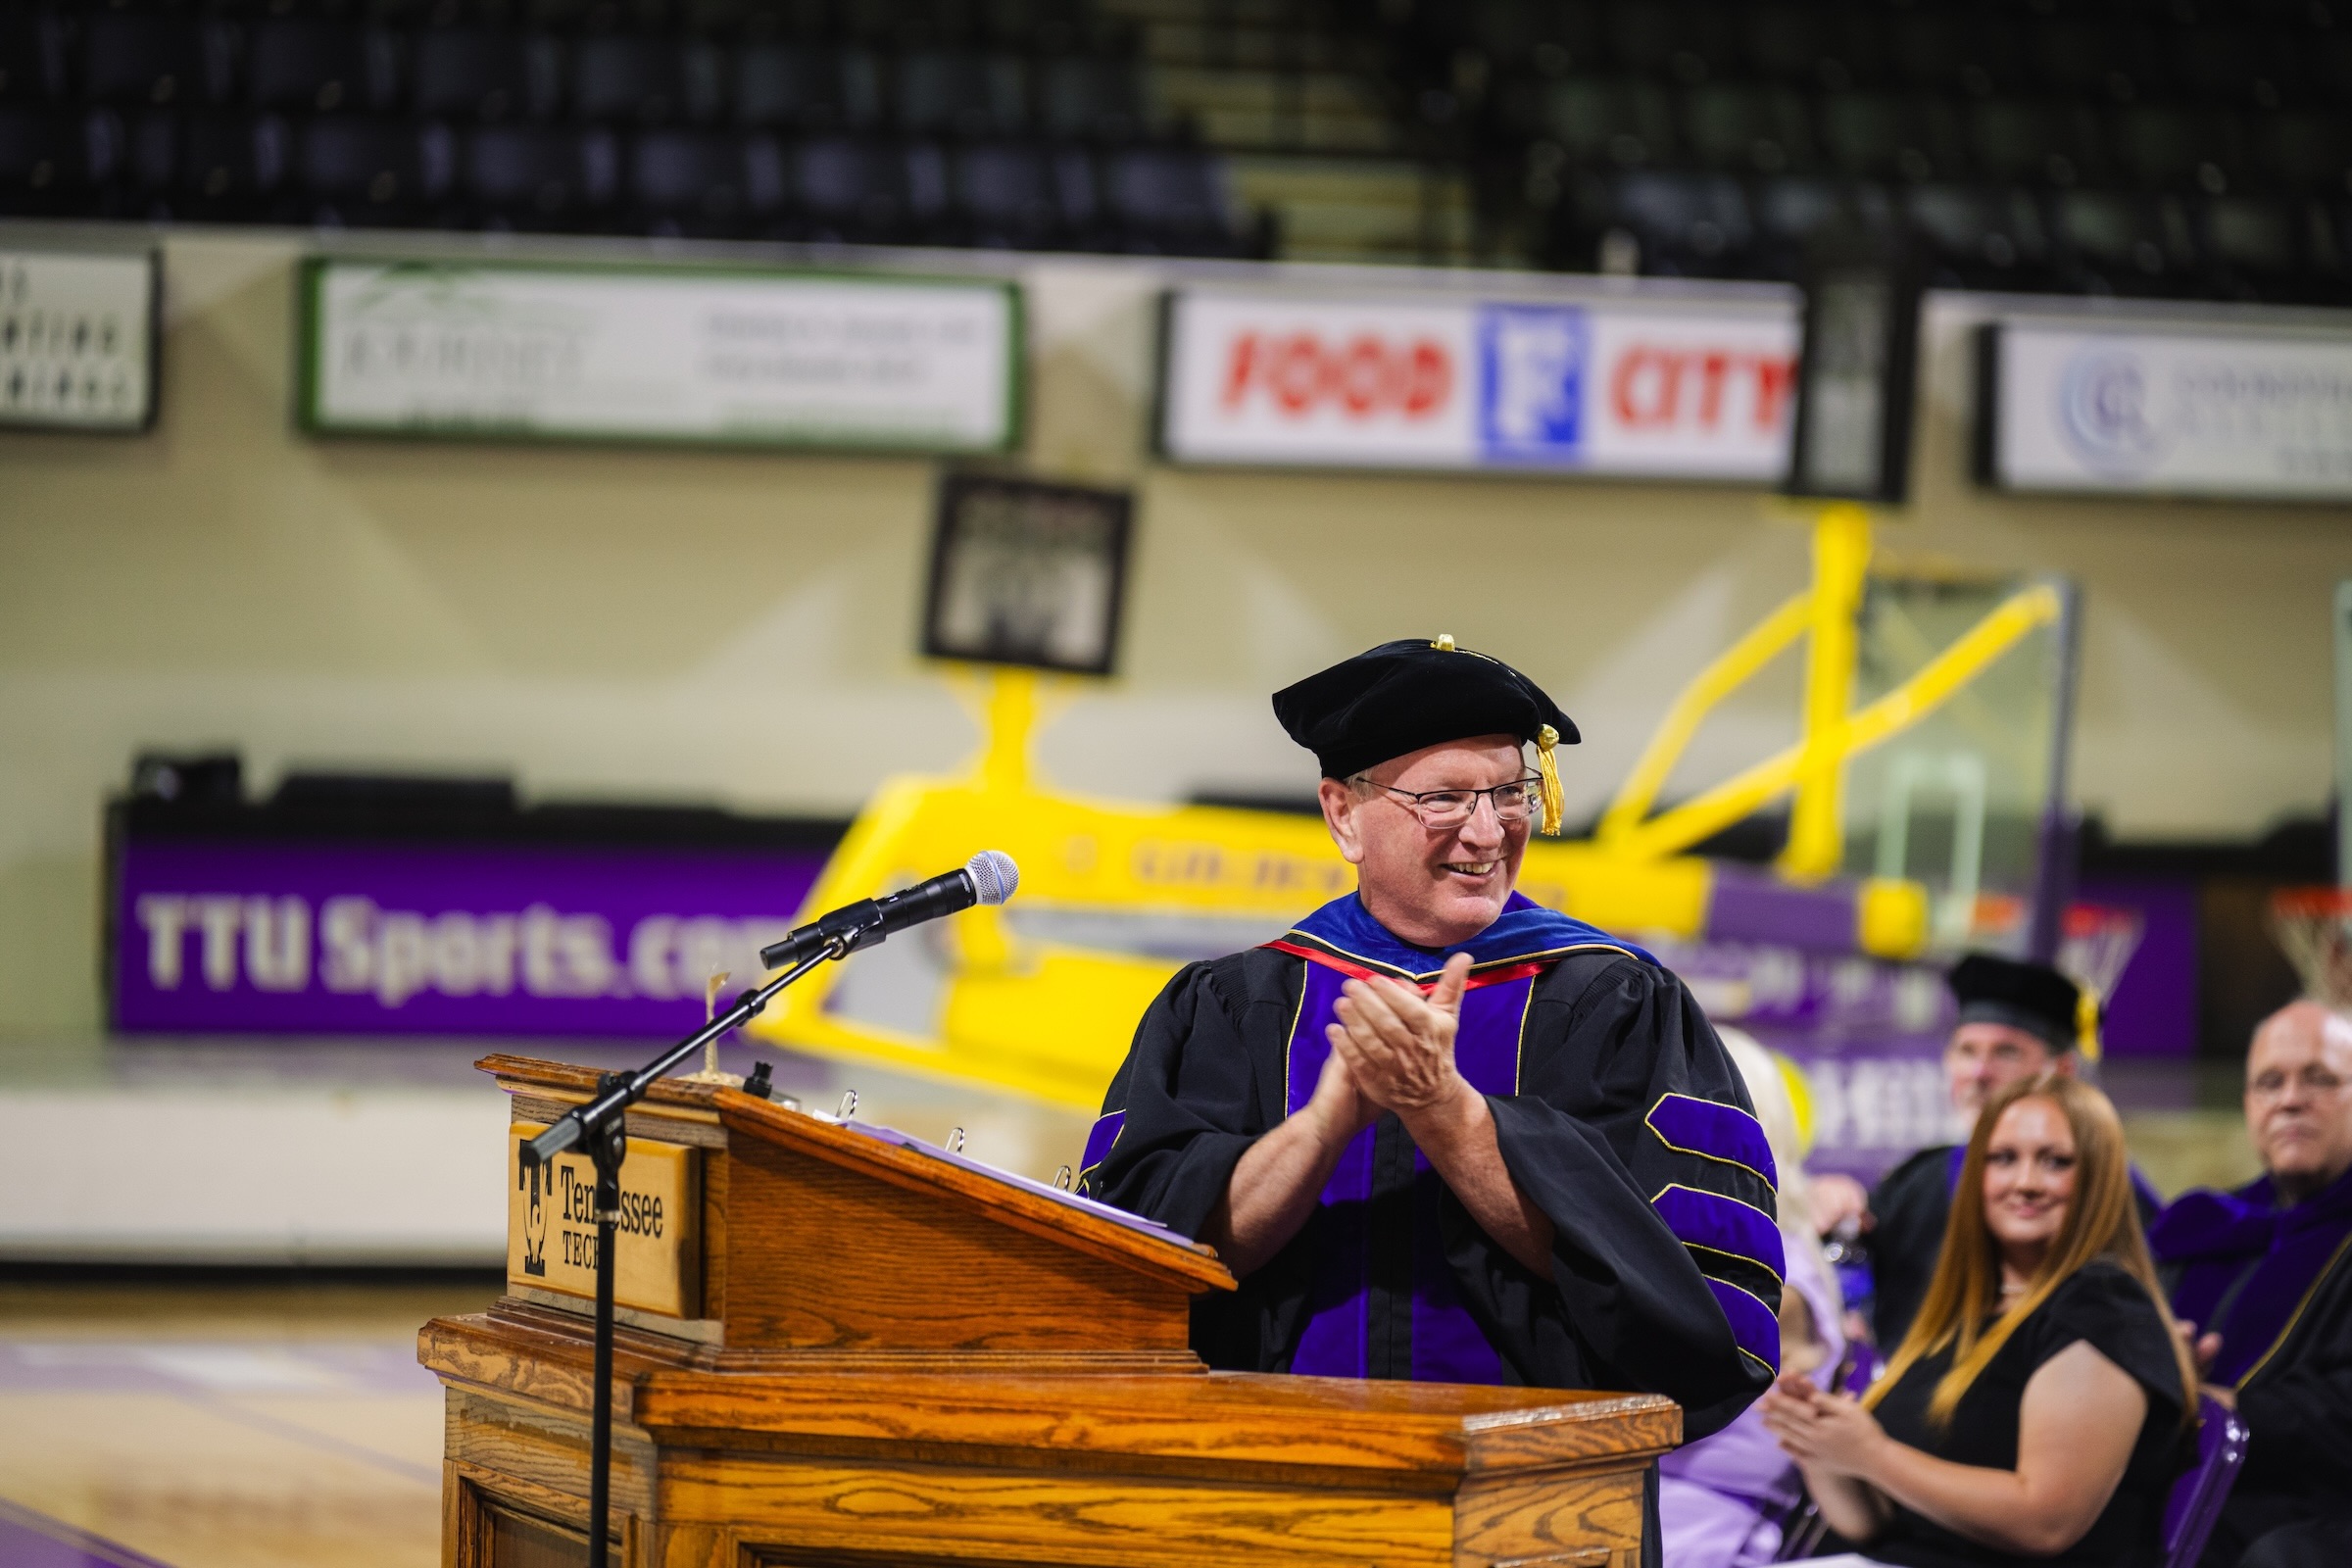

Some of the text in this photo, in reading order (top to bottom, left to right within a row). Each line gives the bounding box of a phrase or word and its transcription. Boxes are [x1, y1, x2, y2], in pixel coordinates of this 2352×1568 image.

[1219, 329, 1454, 423] FOOD
[135, 891, 312, 993] TTU
[561, 1164, 663, 1240] Tenssee
